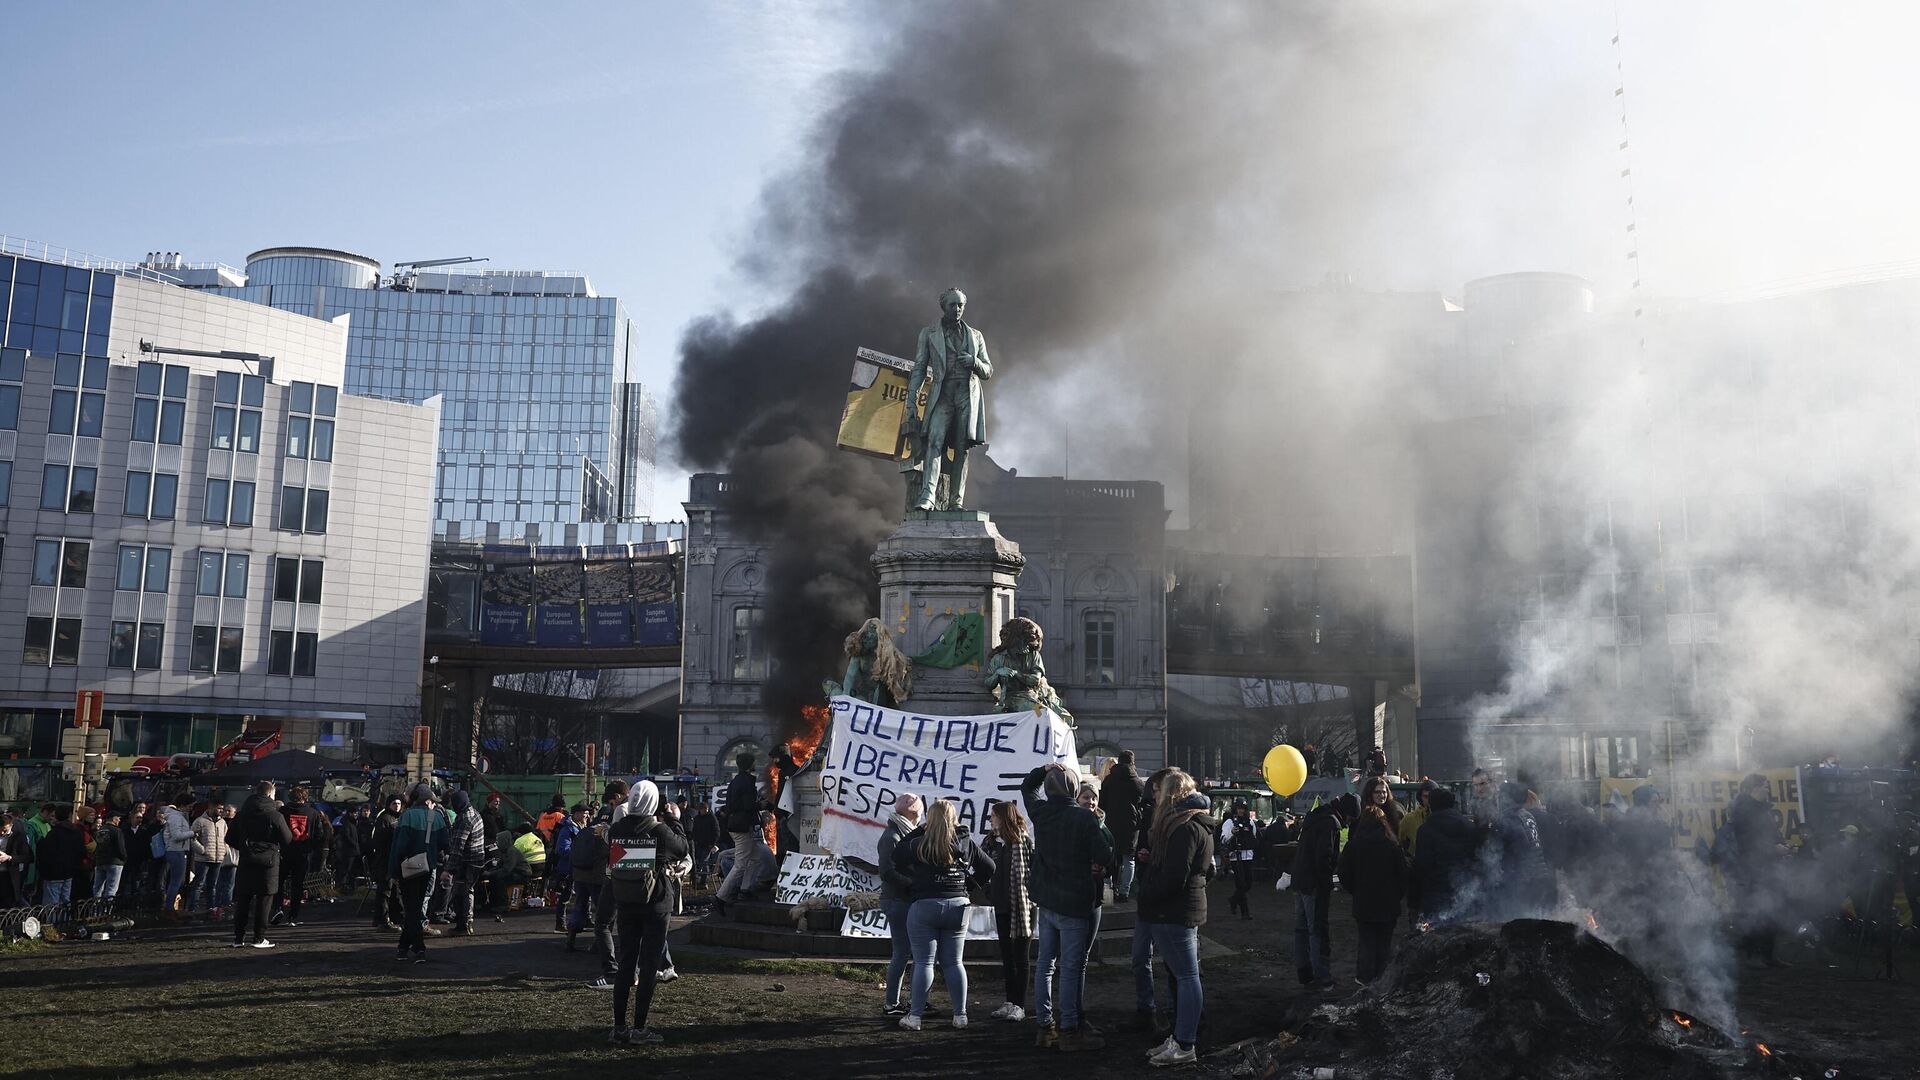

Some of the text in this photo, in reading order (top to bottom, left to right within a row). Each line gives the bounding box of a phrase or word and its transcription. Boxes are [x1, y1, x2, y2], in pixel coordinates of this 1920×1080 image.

[831, 701, 1018, 754] POLITIQUE
[826, 741, 978, 793] LIBERALE
[1727, 778, 1799, 803] FLIE
[627, 838, 656, 846] PALESTINE
